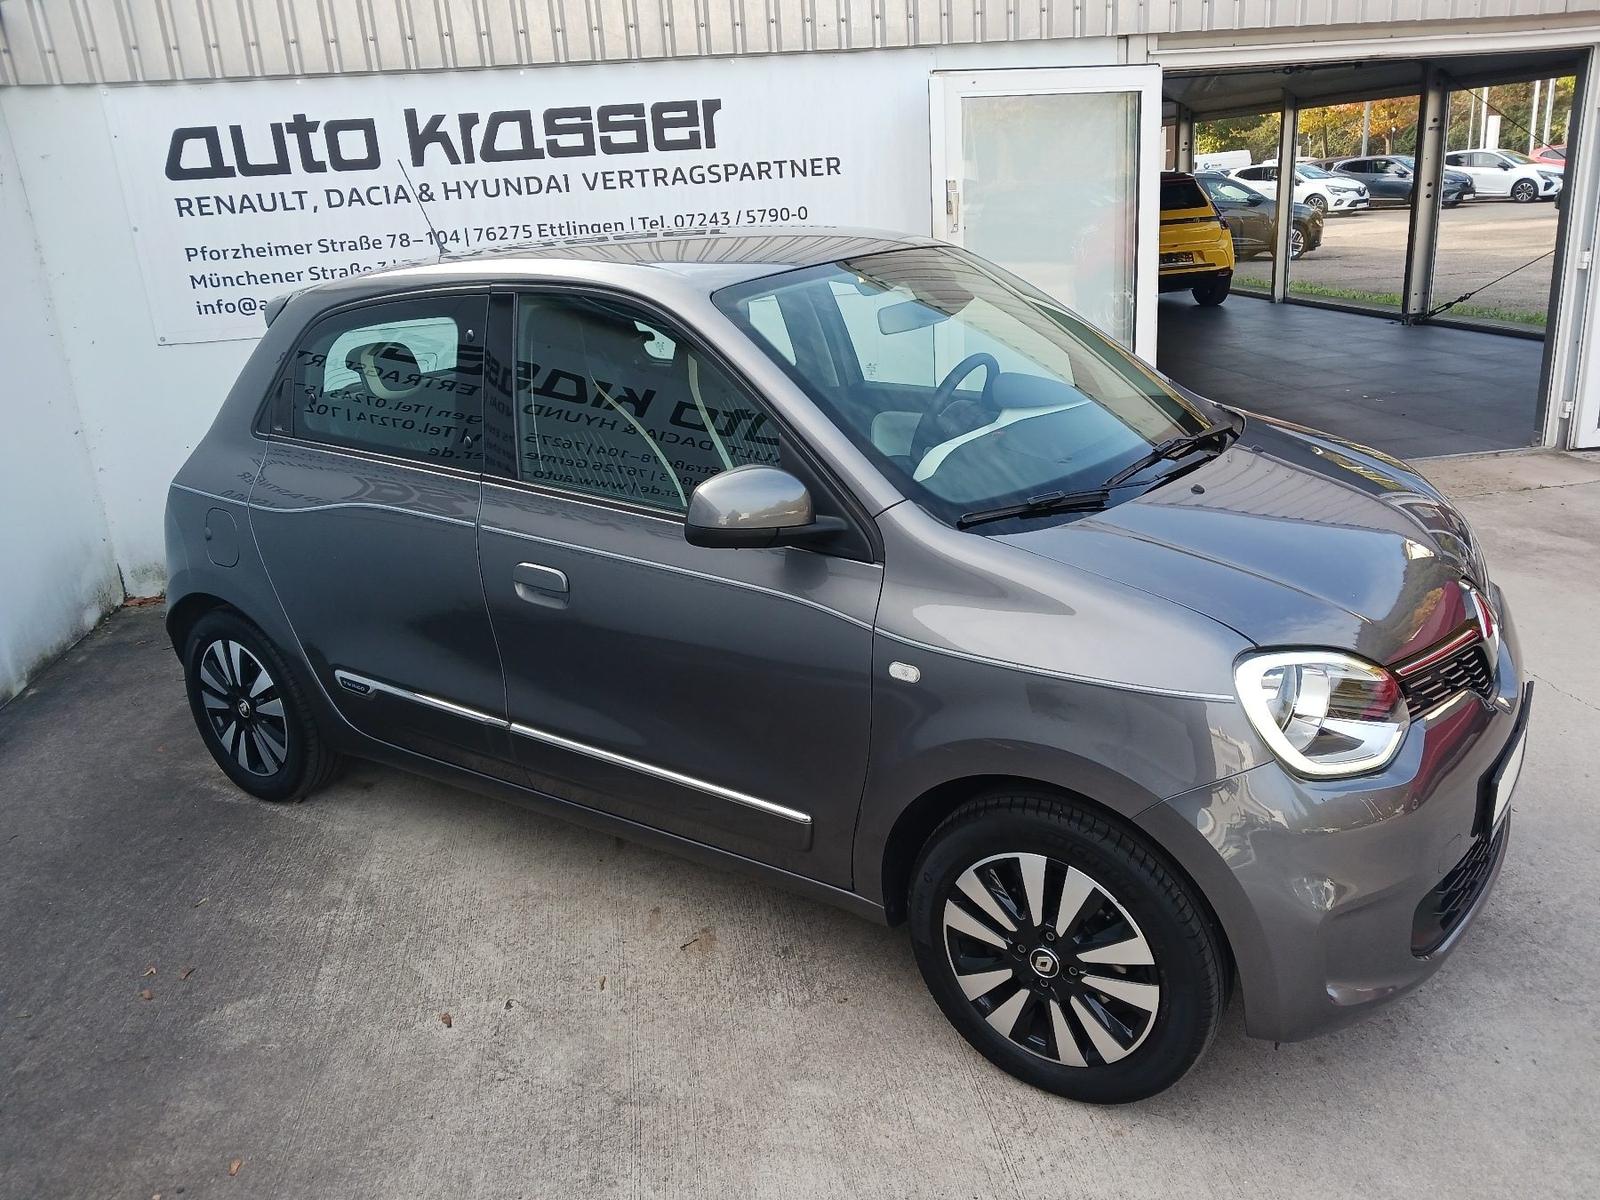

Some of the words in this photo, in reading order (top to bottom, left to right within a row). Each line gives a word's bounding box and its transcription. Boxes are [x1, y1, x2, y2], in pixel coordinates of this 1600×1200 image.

[165, 113, 381, 181] auto
[403, 98, 722, 167] krasser
[174, 190, 318, 218] RENAULT,
[324, 185, 412, 208] DACIA
[417, 182, 436, 203] &
[442, 174, 570, 200] HYUNDAI
[582, 156, 842, 192] VERTRAGSPARTNER
[184, 242, 313, 263] Pforzheimer
[316, 235, 383, 254] Straße
[472, 224, 533, 243] 76275
[536, 220, 625, 238] Ettlingen
[637, 214, 671, 230] Tel.
[674, 210, 731, 228] 07243
[746, 205, 808, 224] 5790-0
[188, 267, 304, 290] Münchener
